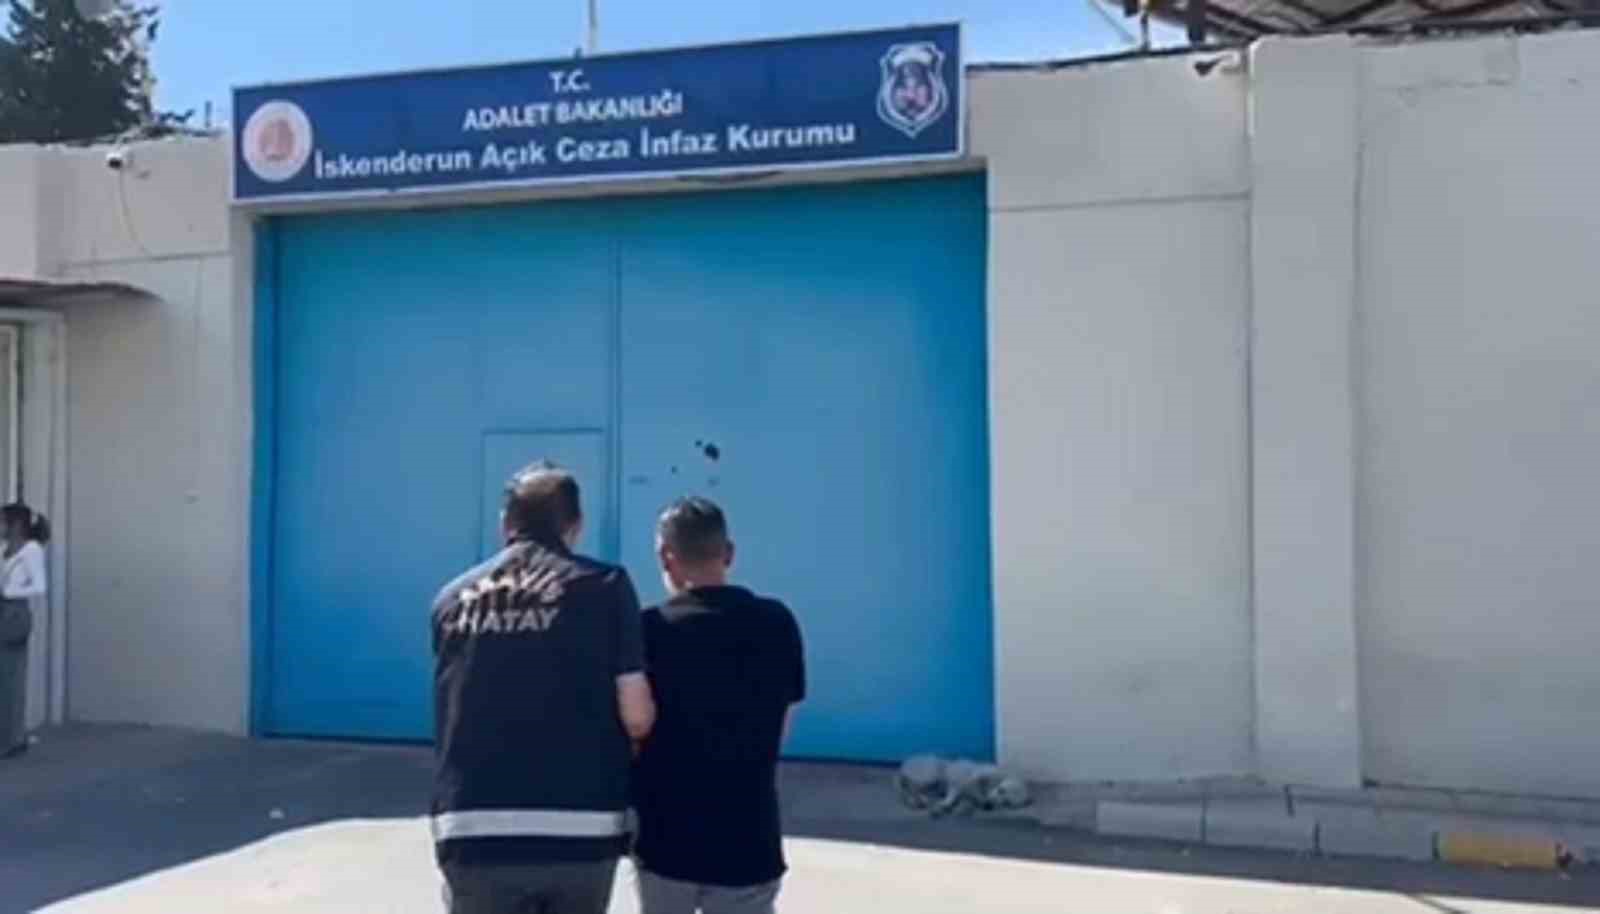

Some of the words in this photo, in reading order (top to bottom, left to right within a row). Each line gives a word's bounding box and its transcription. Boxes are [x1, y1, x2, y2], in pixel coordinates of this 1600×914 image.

[550, 70, 590, 92] T.C.
[463, 104, 550, 130] ADALET
[556, 89, 683, 122] BAKANLIĞI
[314, 150, 471, 178] İskenderun
[481, 140, 546, 171] Açık
[556, 134, 629, 162] Ceza
[641, 127, 718, 157] İnfaz
[727, 122, 856, 151] Kurumu
[459, 608, 558, 633] HATAY
